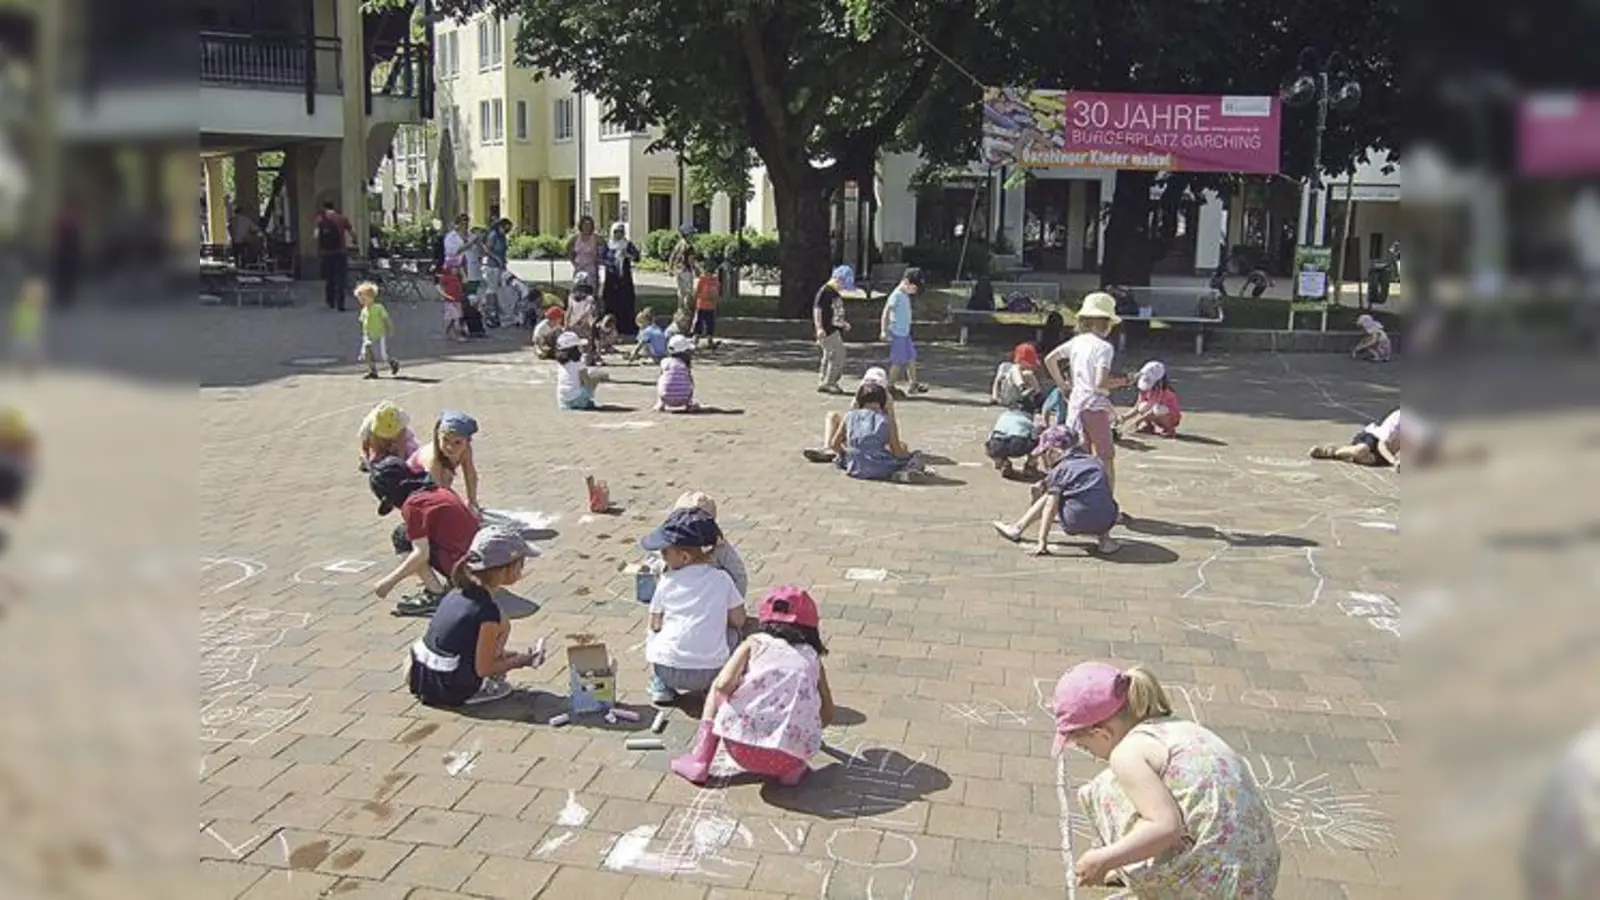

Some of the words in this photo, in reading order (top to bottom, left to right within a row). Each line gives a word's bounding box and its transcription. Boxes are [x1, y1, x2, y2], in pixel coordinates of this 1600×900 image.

[1073, 100, 1109, 127] 30
[1114, 103, 1211, 131] JAHRE
[1181, 134, 1262, 149] GARCHING
